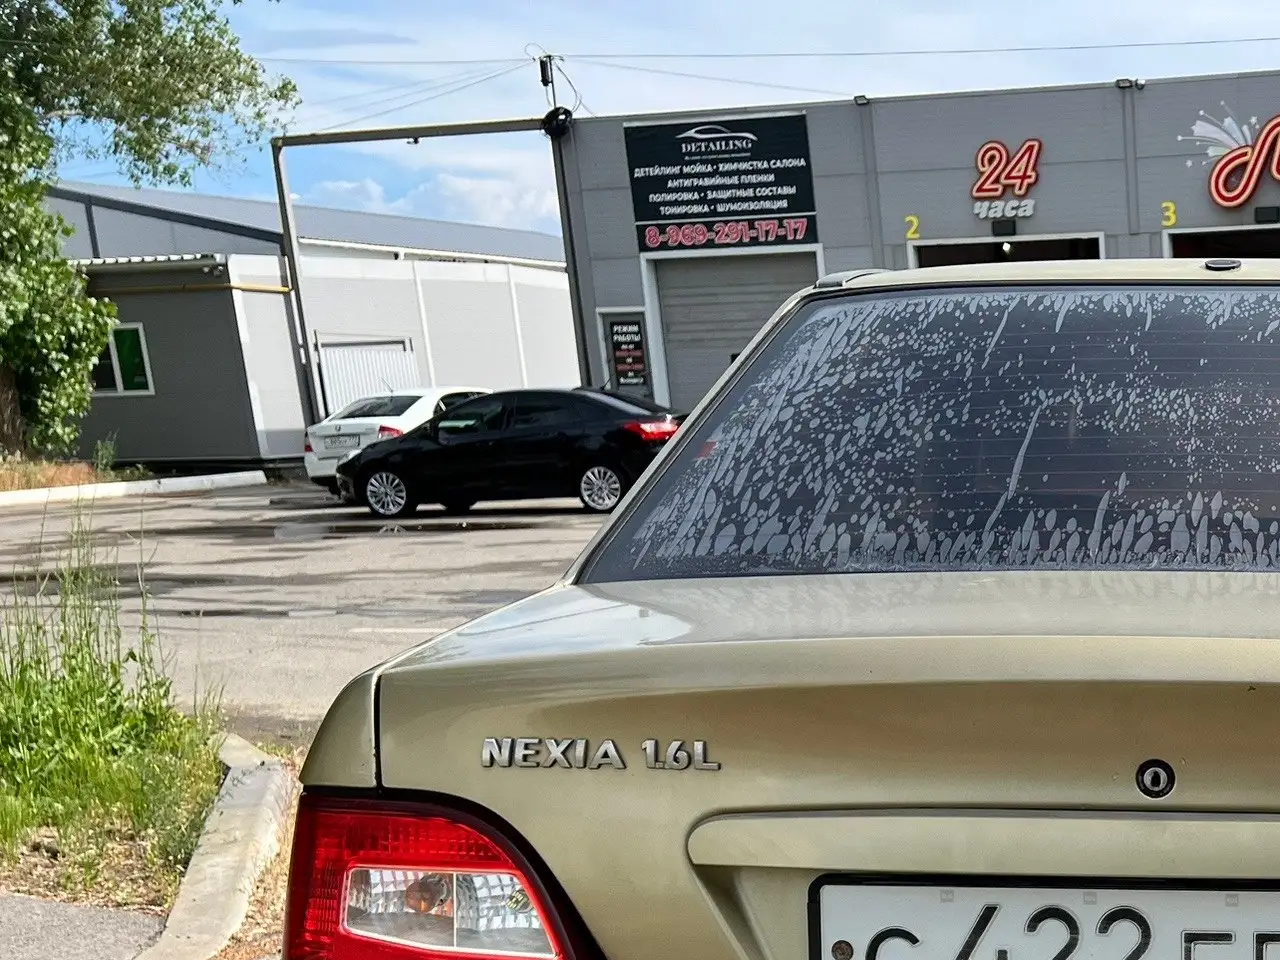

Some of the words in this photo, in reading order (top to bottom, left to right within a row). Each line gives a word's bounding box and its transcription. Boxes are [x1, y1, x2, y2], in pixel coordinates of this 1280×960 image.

[681, 140, 752, 153] DETAILING
[633, 165, 682, 178] ДЕТЕЙЛИНГ
[682, 162, 713, 174] МОЙКА
[717, 160, 770, 172] ХИМЧИСТКА
[769, 158, 807, 169] САЛОНА
[971, 138, 1043, 199] 24
[667, 175, 740, 189] АНТИГРАВИЙНЫЕ
[740, 173, 776, 184] ПЛЕНКИ
[648, 191, 700, 203] ПОЛИРОВКА
[706, 187, 756, 200] ЗАЩИТНЫЕ
[755, 185, 797, 197] СОСТАВЫ
[659, 203, 710, 216] ТОНИРОВКА
[716, 199, 789, 213] ШУМОИЗОЛЯЦИЯ
[973, 199, 1036, 219] часа
[1161, 201, 1178, 227] 3
[645, 218, 808, 247] 8-969-291-17-17
[904, 214, 920, 239] 2
[481, 737, 627, 770] NEXIA
[641, 739, 722, 771] 1.6L
